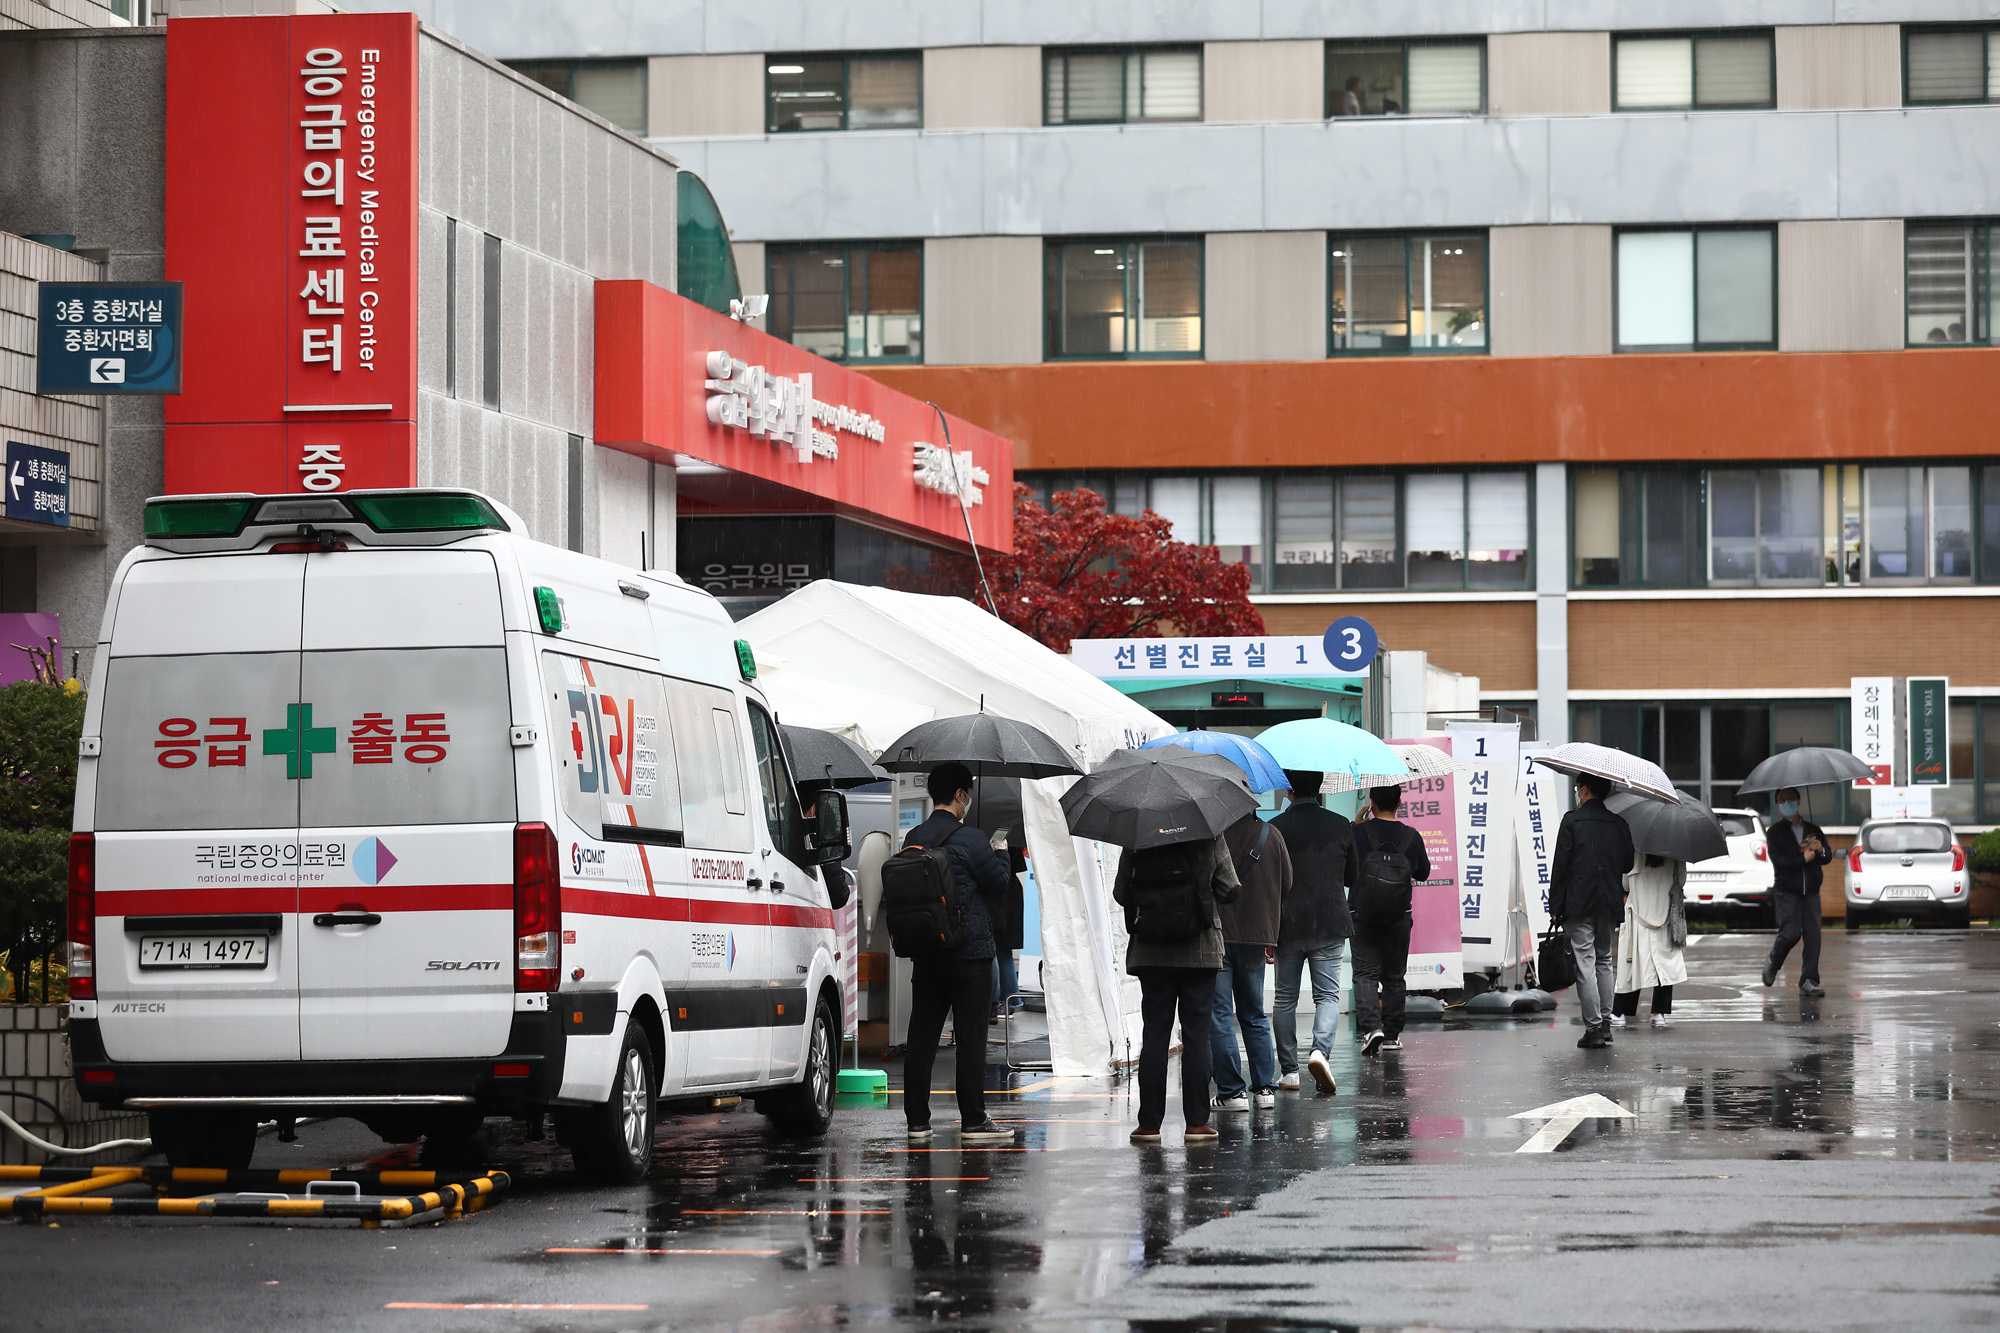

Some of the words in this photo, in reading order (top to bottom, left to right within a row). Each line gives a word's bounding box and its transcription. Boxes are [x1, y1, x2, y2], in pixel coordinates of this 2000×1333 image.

[357, 49, 381, 182] Emergency
[299, 48, 347, 371] 응급의료센터
[358, 190, 380, 282] Medical
[56, 301, 85, 322] 3층
[92, 300, 163, 323] 중환자실
[64, 329, 153, 352] 중환자면회
[359, 291, 379, 371] Center
[28, 459, 39, 480] 3층
[40, 461, 67, 484] 중환자실
[298, 444, 346, 492] 중
[34, 490, 66, 514] 중환자면회
[1340, 628, 1363, 660] 3
[1113, 643, 1267, 670] 선별진료실
[1295, 645, 1309, 665] 1
[636, 716, 656, 730] DISASTER
[1864, 686, 1881, 758] 장례식장
[155, 717, 252, 769] 응급
[347, 712, 451, 765] 출동
[636, 733, 646, 746] AND
[1474, 737, 1488, 758] 1
[636, 749, 658, 764] INFECTION
[1524, 755, 1536, 775] 2
[635, 766, 656, 780] RESPONSE
[635, 783, 652, 797] VEHICLE
[195, 843, 345, 869] 국립중앙의료원
[1462, 770, 1490, 919] 선별진료실
[197, 873, 241, 883] national
[243, 872, 287, 882] medical
[289, 872, 325, 882] center
[152, 941, 192, 961] 71서
[203, 940, 256, 961] 1497
[692, 934, 726, 956] 국립중앙의료원
[425, 961, 501, 971] SOLATI
[112, 1003, 166, 1013] AUTECH
